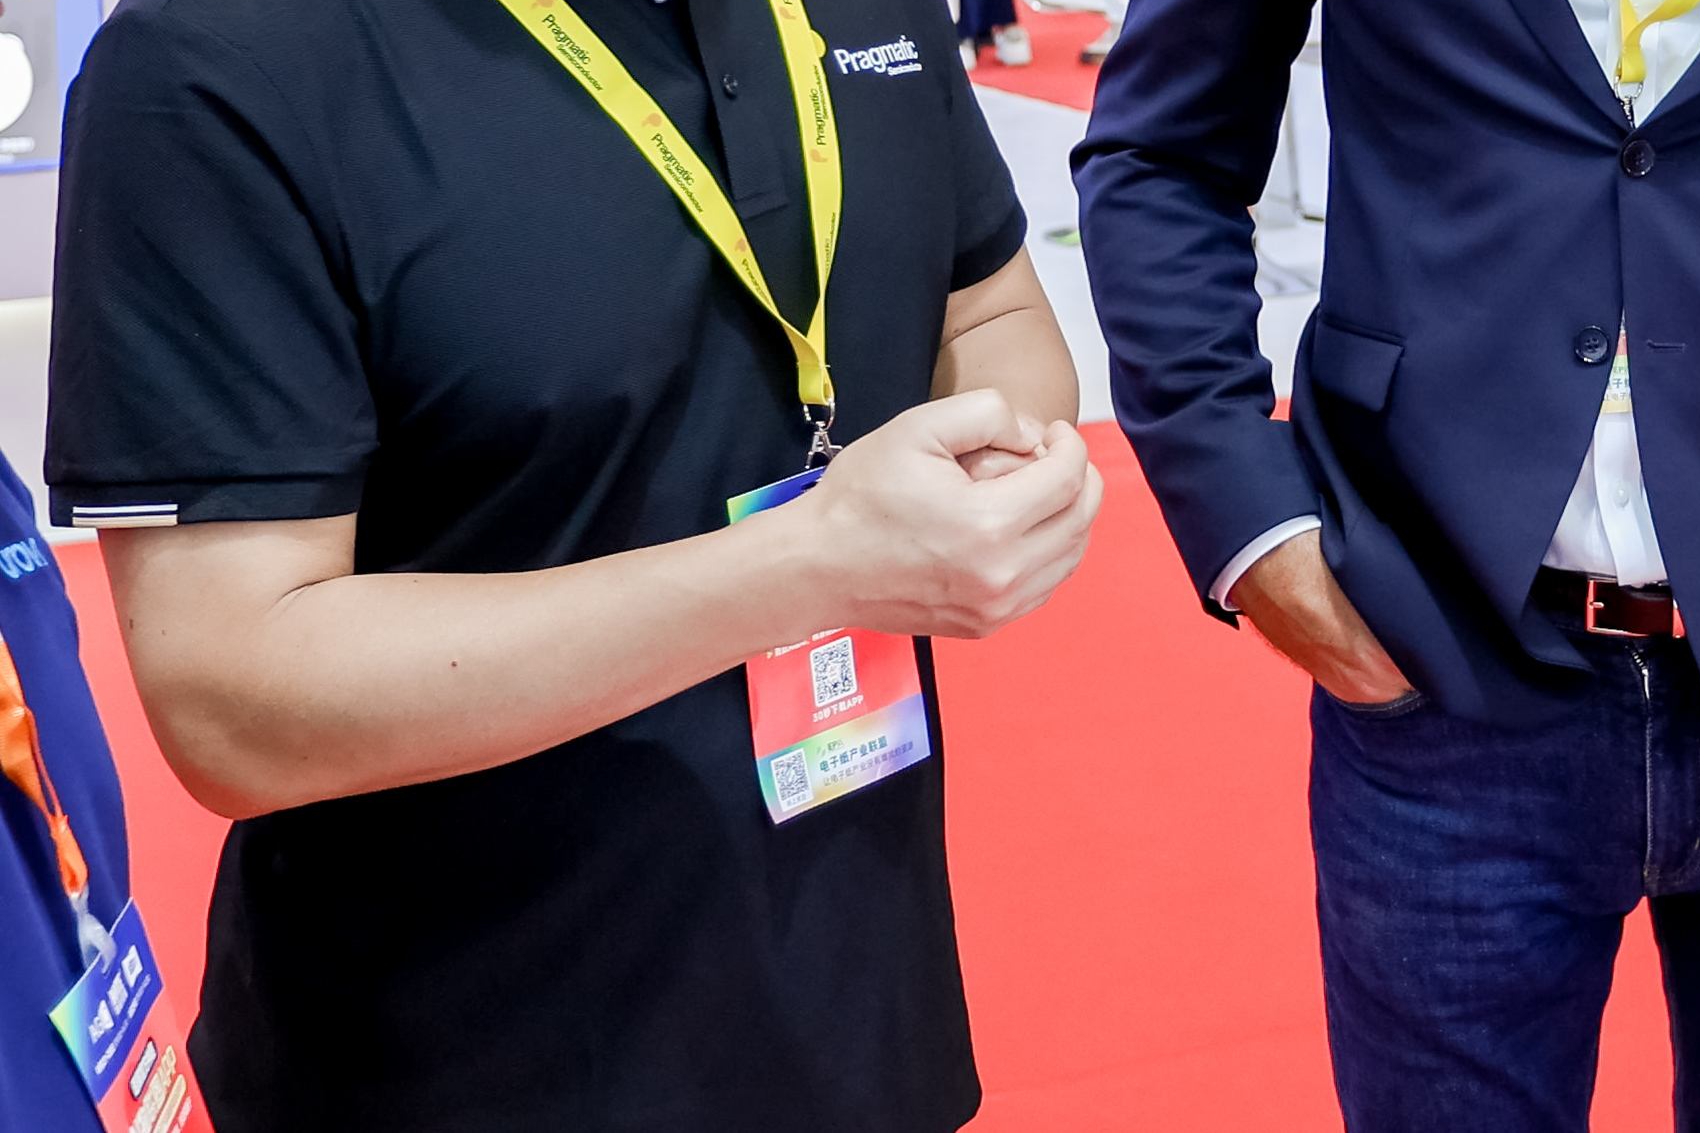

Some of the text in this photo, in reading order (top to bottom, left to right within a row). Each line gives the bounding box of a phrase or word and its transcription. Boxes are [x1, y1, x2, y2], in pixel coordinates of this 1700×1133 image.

[542, 13, 591, 69] Pragmatic
[834, 34, 918, 74] Pragmatic
[556, 43, 603, 92] Semiconductor
[811, 88, 826, 146] Pragmatic
[651, 133, 695, 189] Pragmatic
[664, 164, 704, 213] Semiconductor
[819, 735, 888, 773] 电子纸产业联盟
